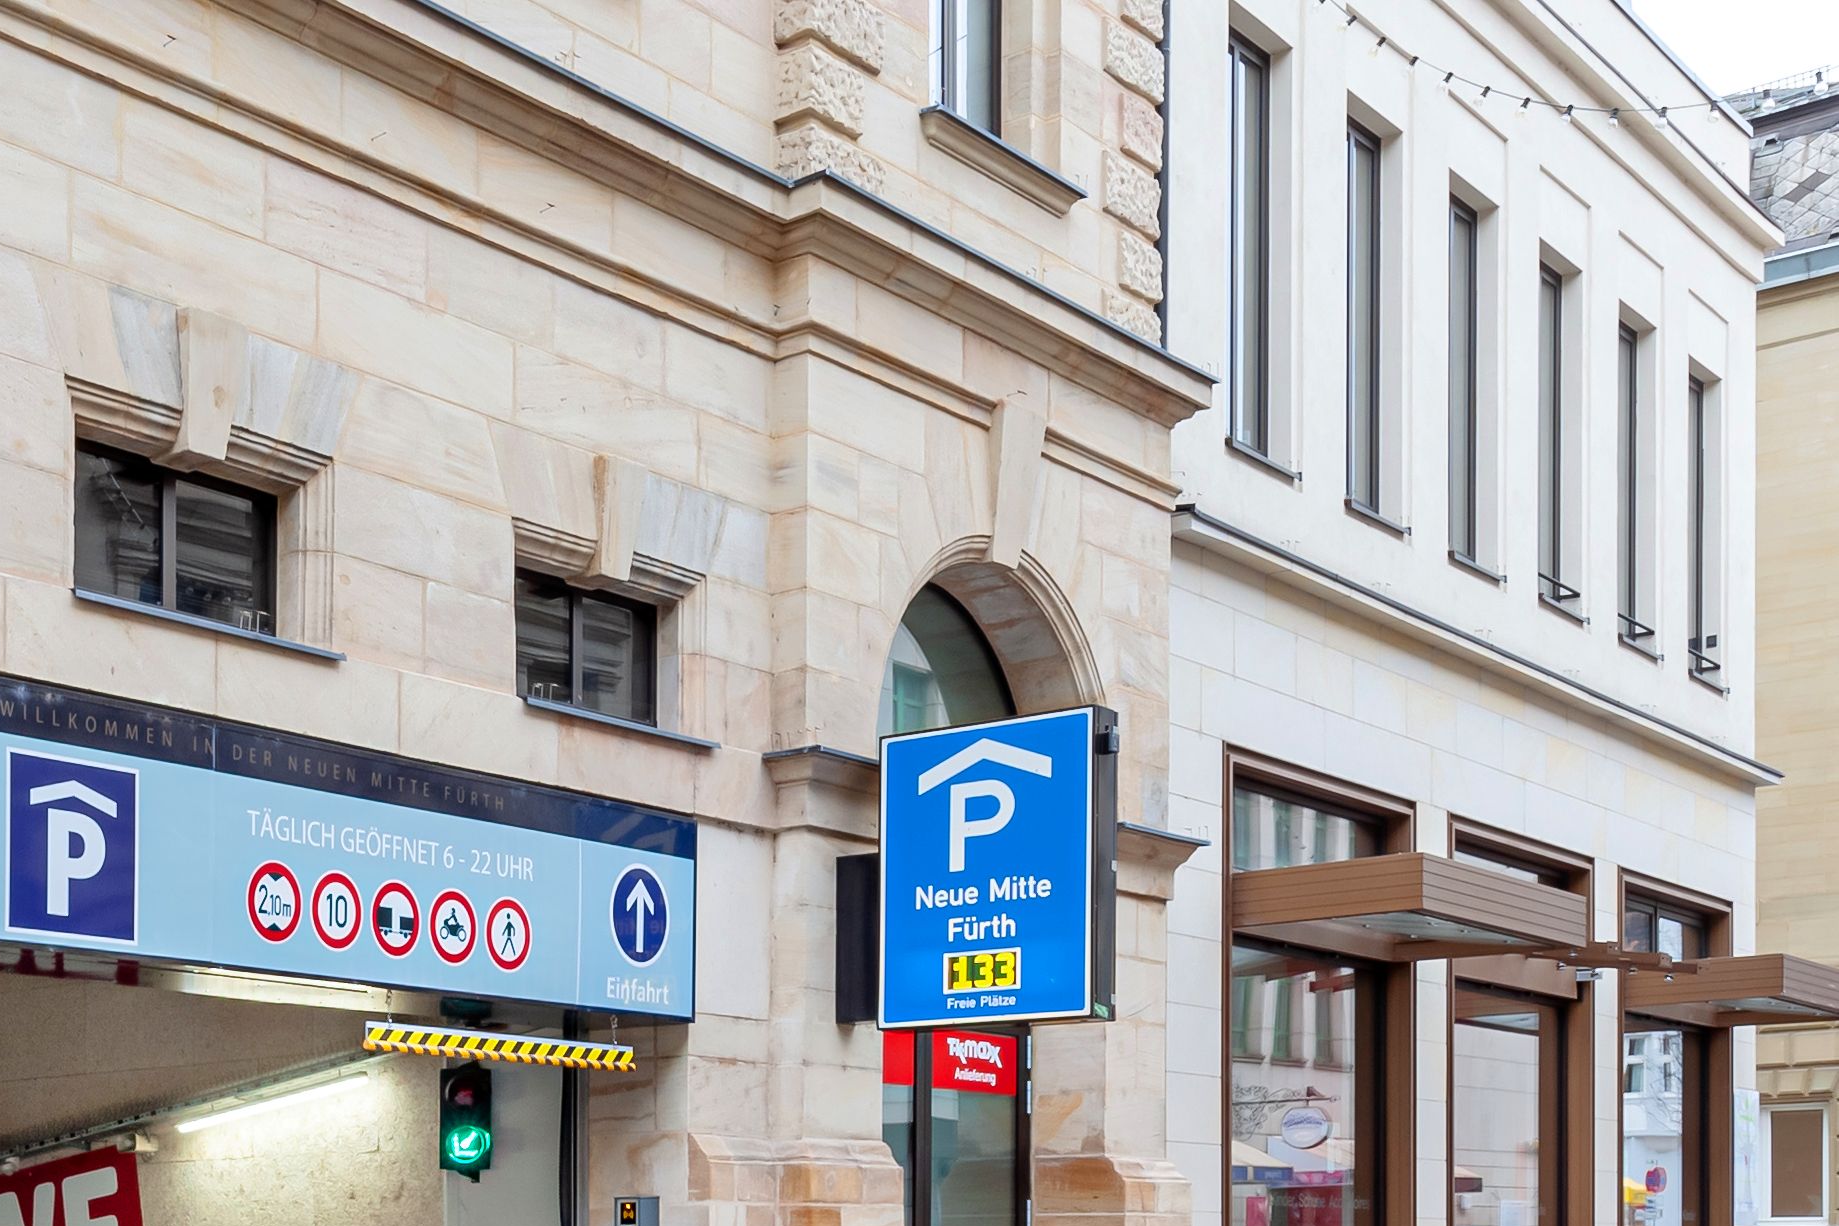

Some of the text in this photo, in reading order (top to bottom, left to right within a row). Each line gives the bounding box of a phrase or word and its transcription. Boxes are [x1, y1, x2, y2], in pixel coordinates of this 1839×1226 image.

[0, 699, 173, 747] WILLKOMMEN
[193, 736, 215, 757] IN
[233, 744, 272, 767] DER
[288, 755, 356, 783] NEUEN
[371, 772, 429, 798] MITTE
[444, 786, 504, 811] FÜRTH
[949, 779, 1016, 873] P
[47, 807, 106, 917] P
[247, 808, 335, 849] TÄGLICH
[340, 826, 439, 866] GEÖFFNET
[471, 849, 491, 875] 22
[497, 854, 534, 882] UHR
[326, 893, 348, 928] 10
[915, 875, 1053, 910] Neue Mitte
[947, 912, 1017, 942] Fürth
[952, 951, 1016, 991] 133
[606, 976, 670, 1005] Einfahrt
[946, 994, 1017, 1009] Freie Plätze
